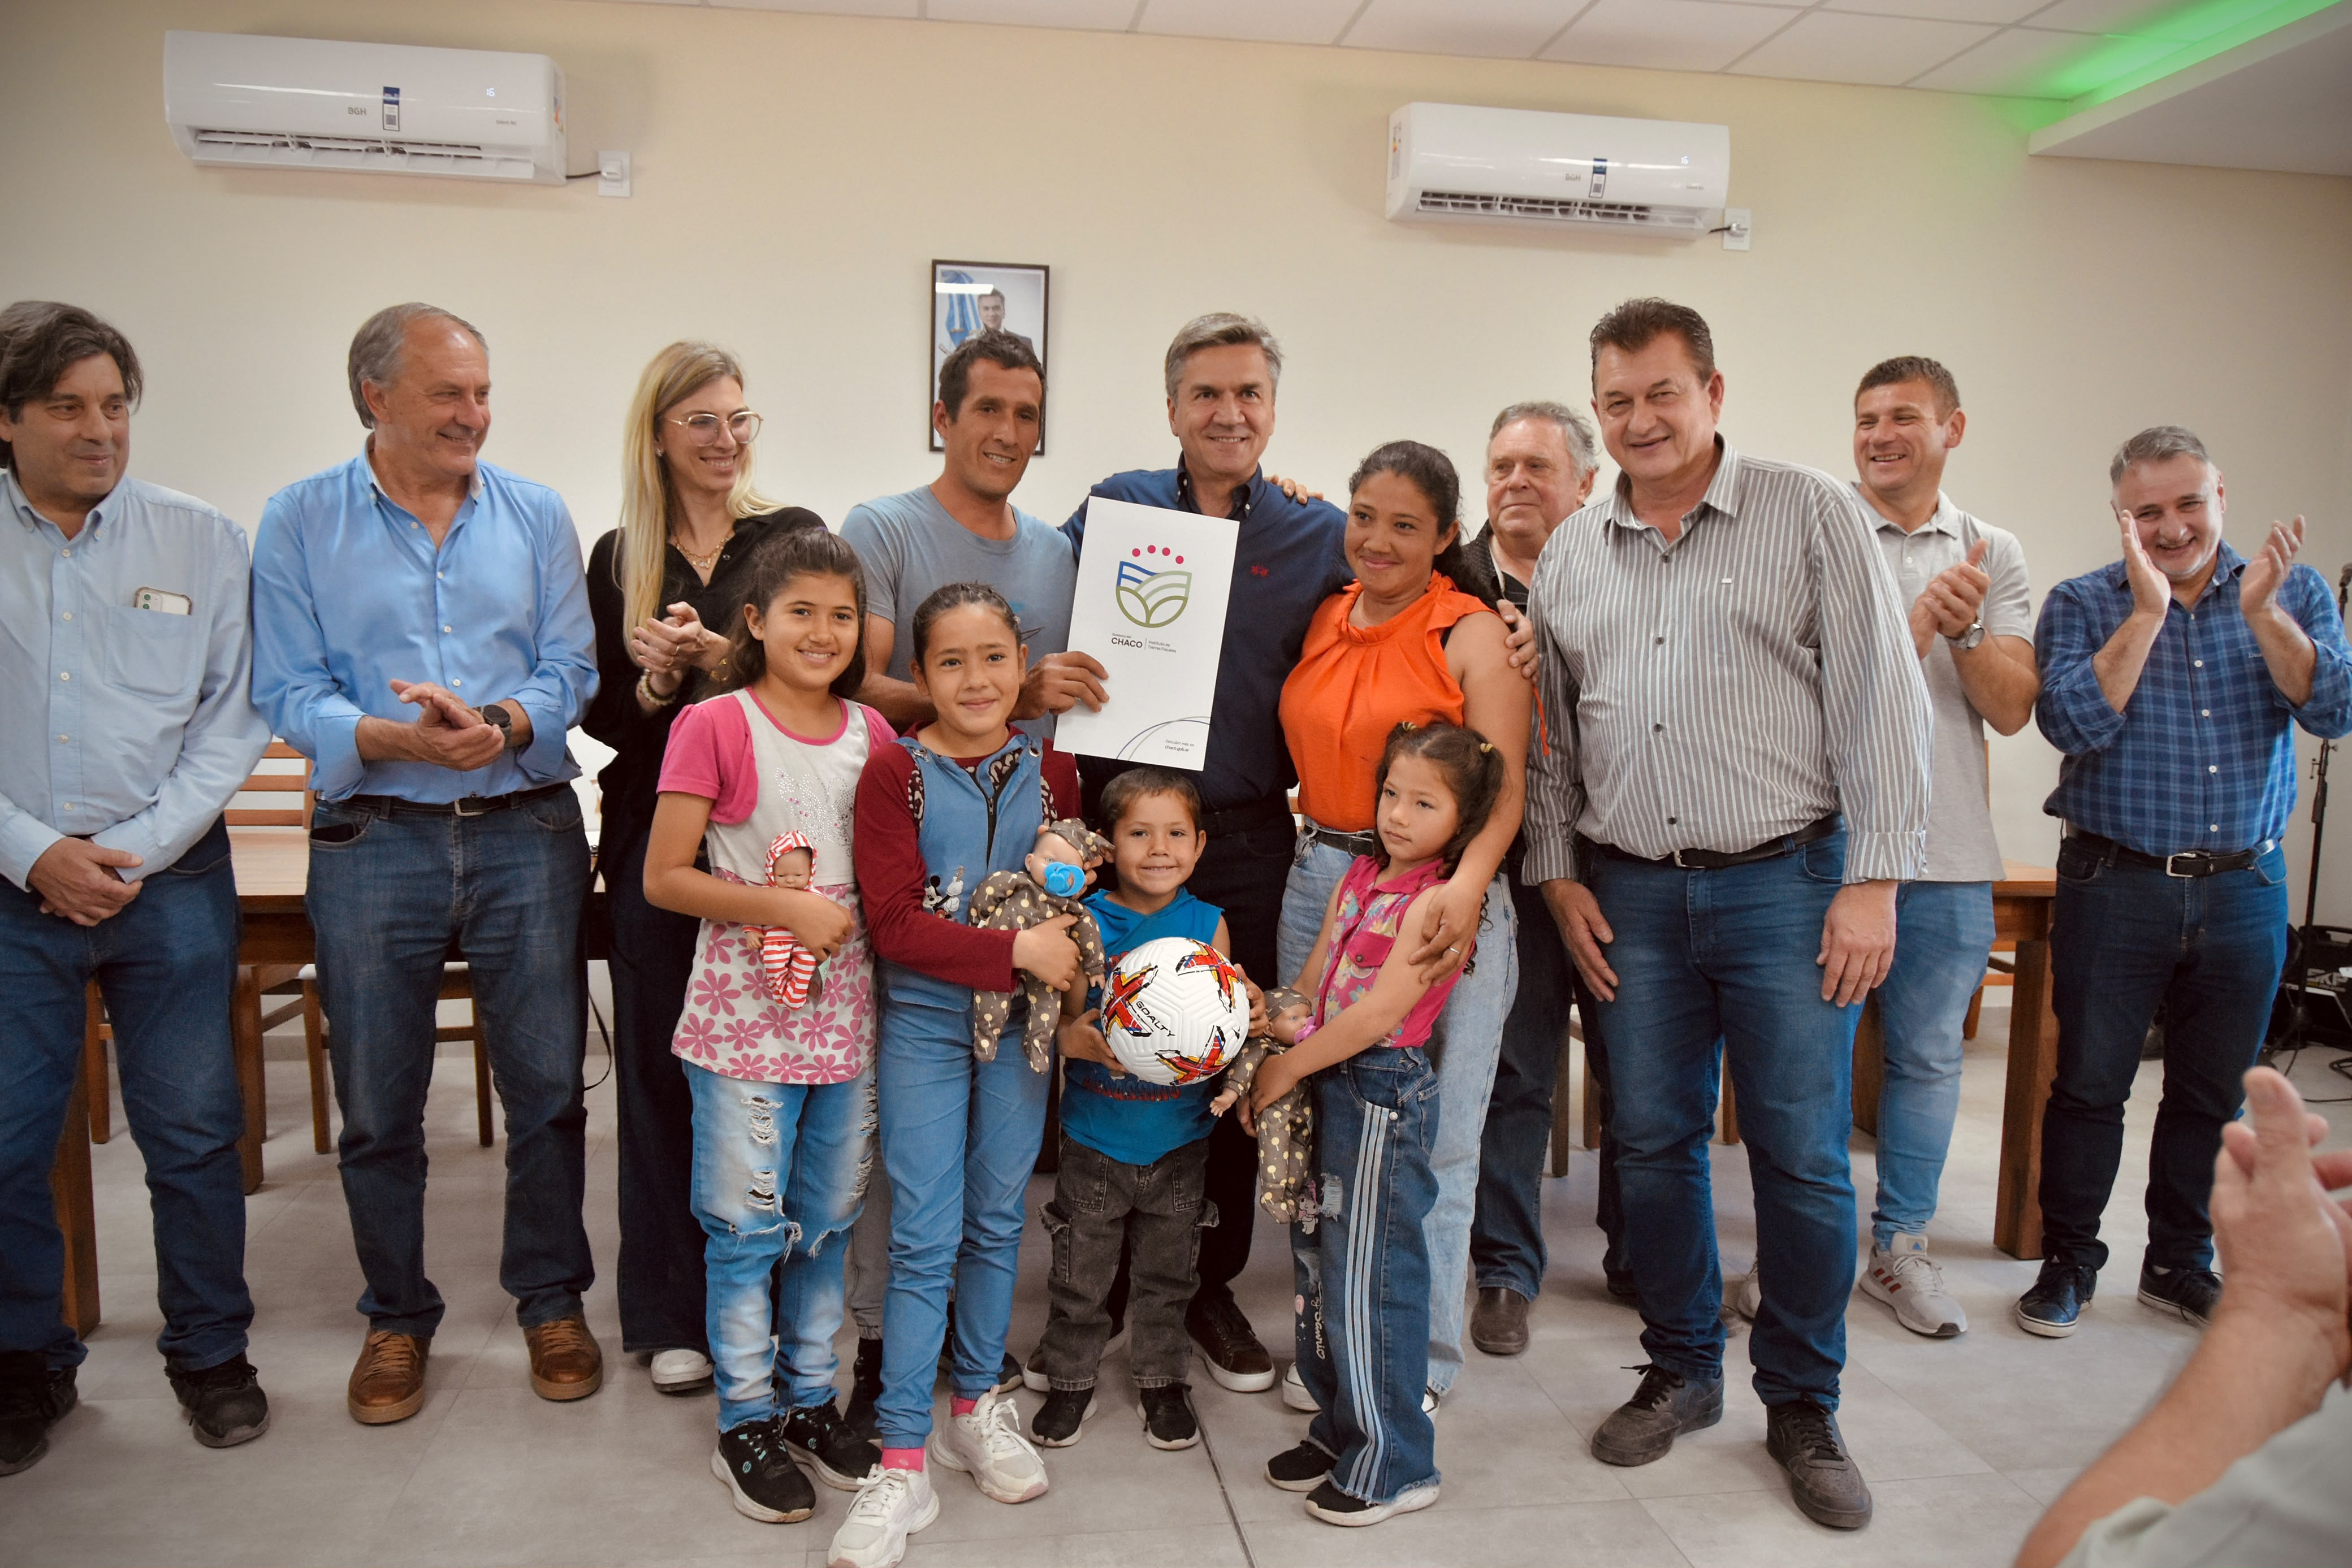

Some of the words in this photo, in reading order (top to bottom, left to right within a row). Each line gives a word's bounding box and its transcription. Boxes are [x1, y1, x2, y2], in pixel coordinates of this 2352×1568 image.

[348, 107, 366, 115] BGH
[1111, 637, 1143, 648] CHACO
[1136, 1001, 1176, 1037] GOALTY
